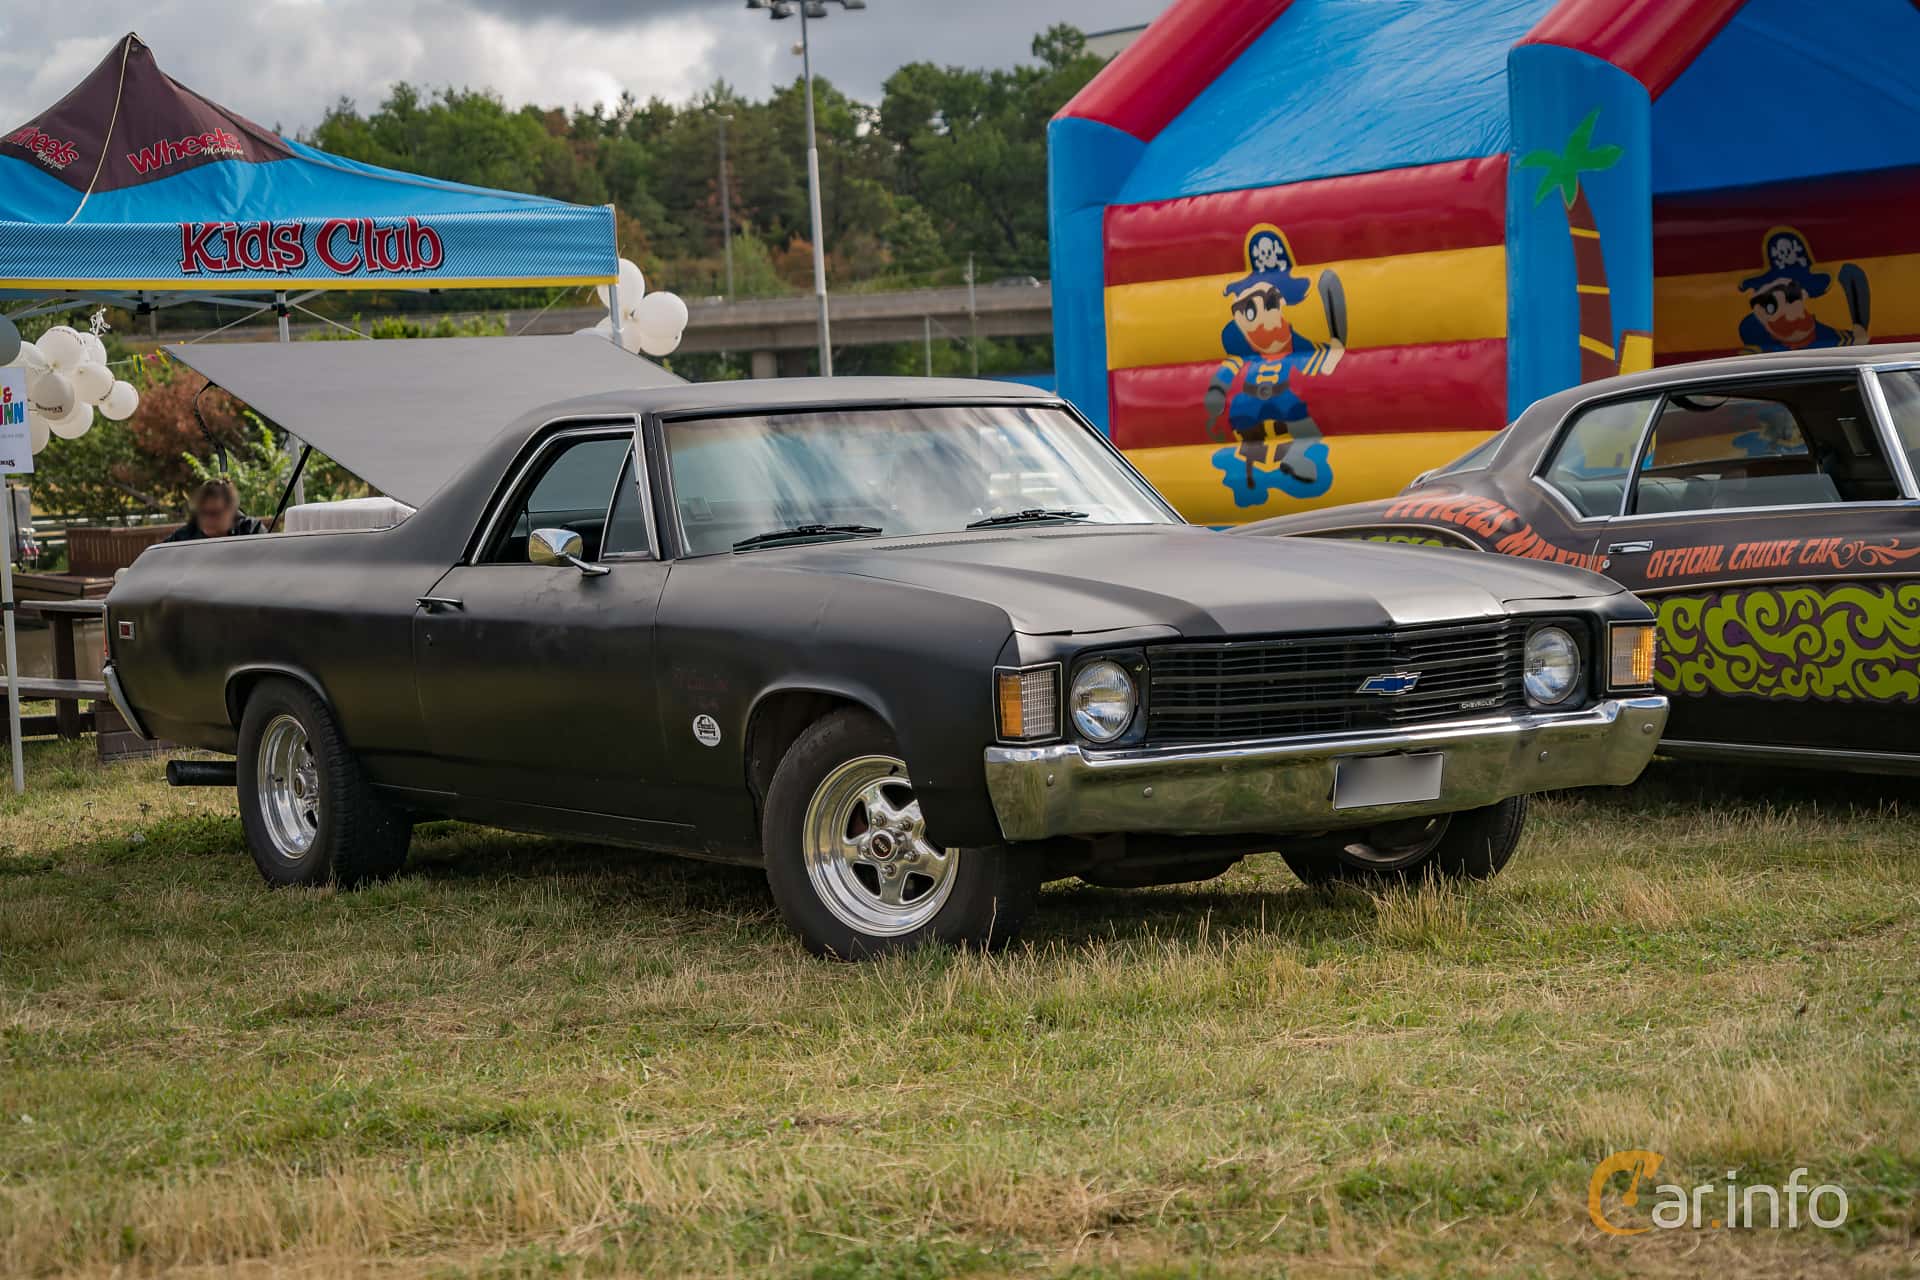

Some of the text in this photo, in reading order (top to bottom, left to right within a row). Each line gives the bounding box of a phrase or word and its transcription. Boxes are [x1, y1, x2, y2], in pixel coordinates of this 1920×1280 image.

[127, 127, 241, 174] Wheels
[178, 217, 444, 275] Kids Club
[1647, 537, 1847, 579] OFFICIAL CRUISE CAR
